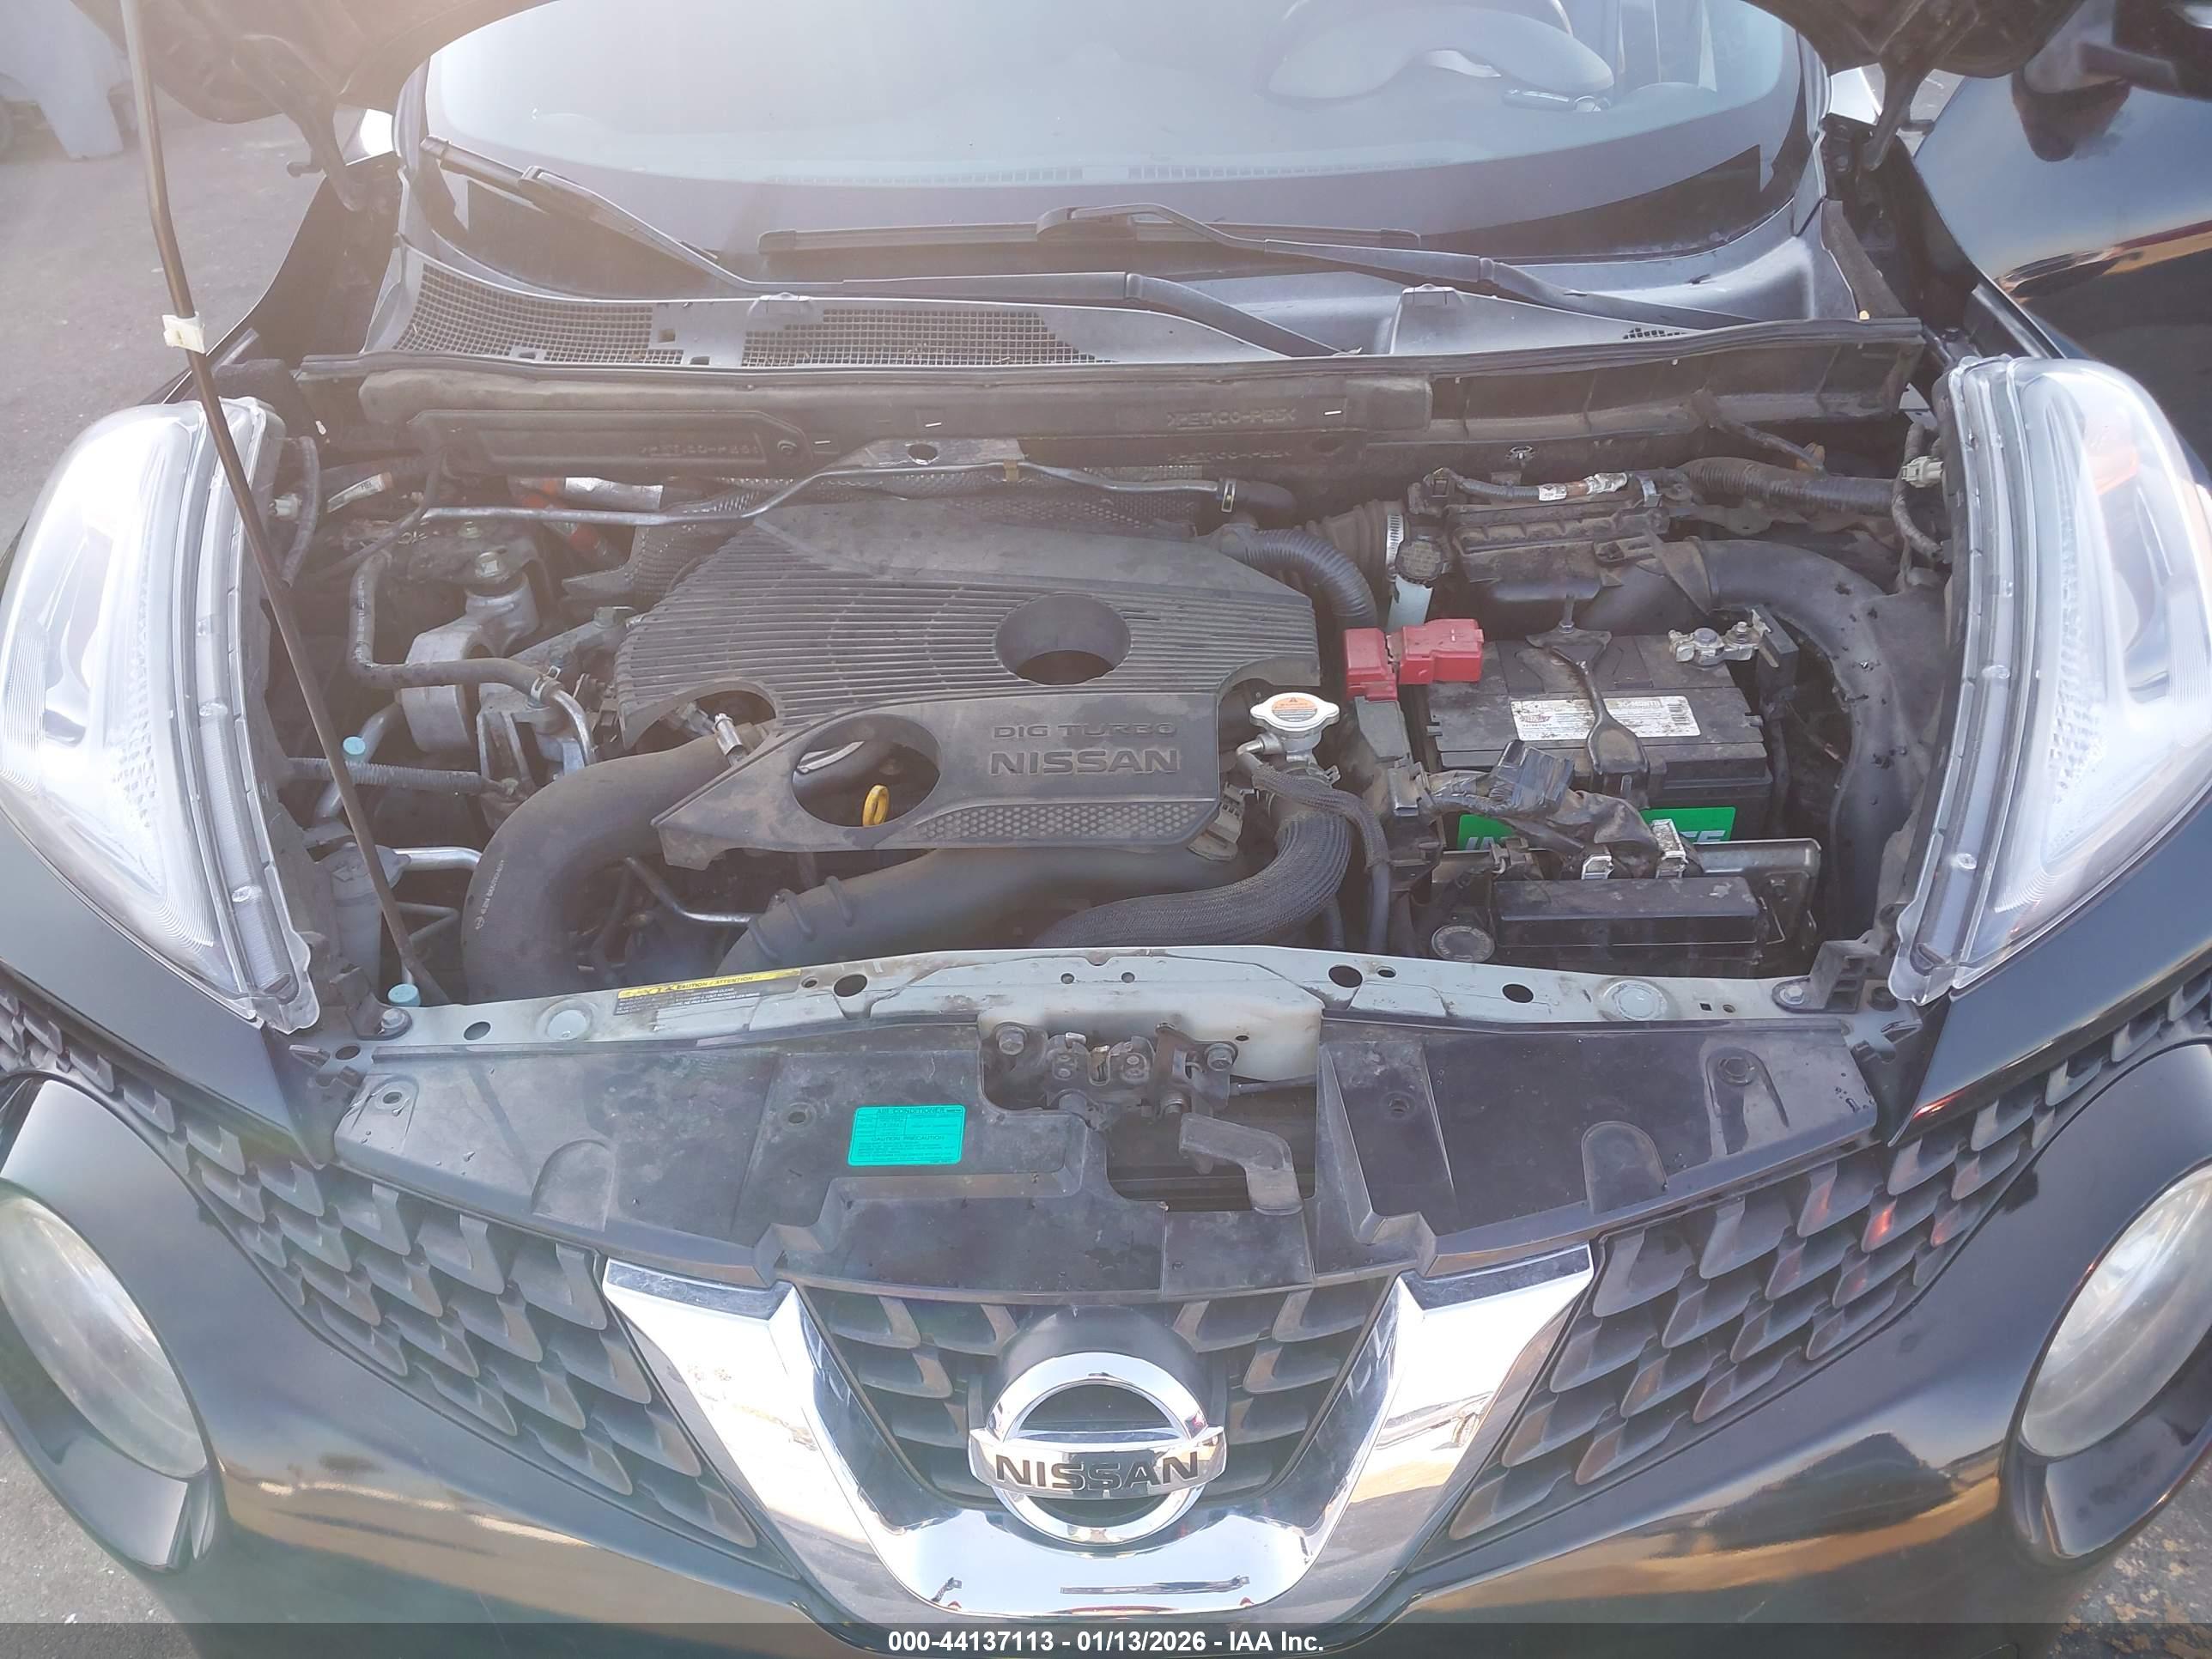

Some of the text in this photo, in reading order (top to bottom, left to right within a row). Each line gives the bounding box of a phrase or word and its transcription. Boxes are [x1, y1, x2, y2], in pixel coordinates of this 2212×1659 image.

[993, 724, 1177, 738] DIG TURBO
[991, 749, 1180, 775] NISSAN
[995, 1451, 1200, 1491] NISSAN
